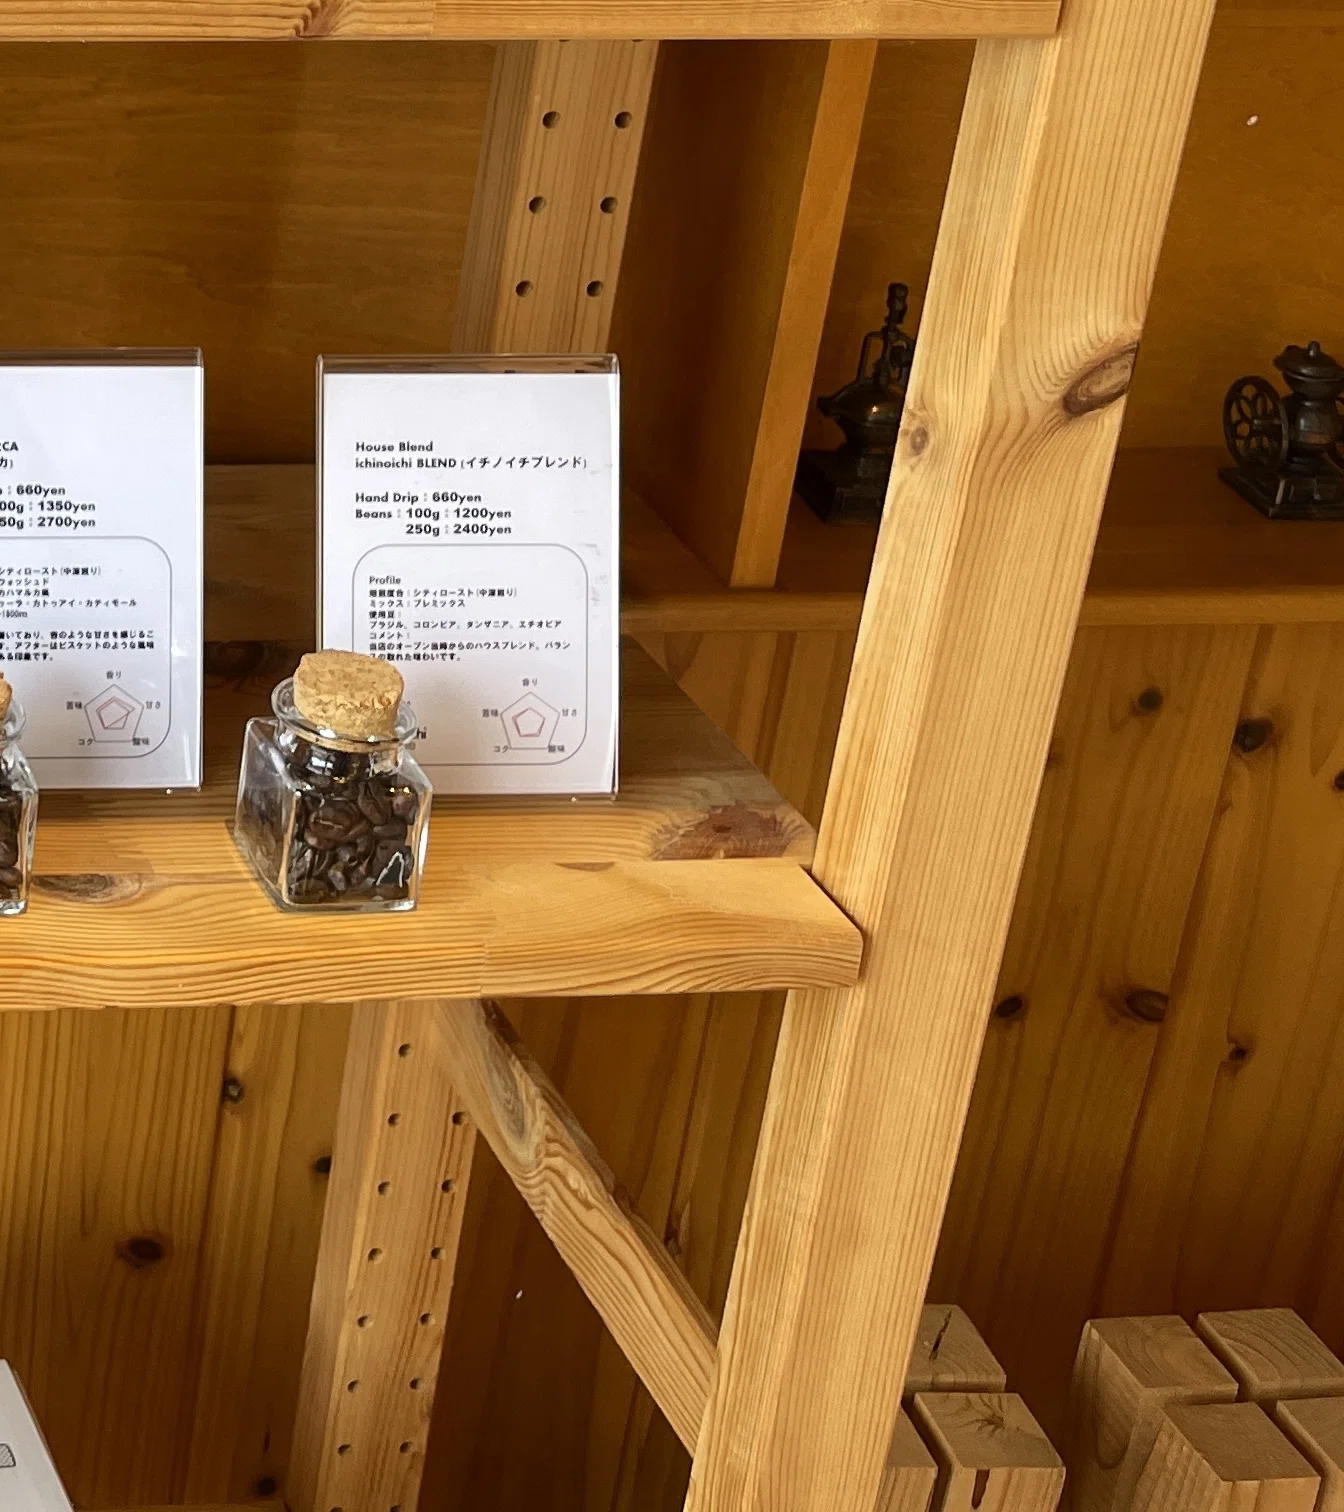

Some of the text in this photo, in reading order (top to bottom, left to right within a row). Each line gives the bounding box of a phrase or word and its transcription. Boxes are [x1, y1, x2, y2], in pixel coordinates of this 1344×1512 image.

[356, 442, 433, 452] House Blend
[355, 456, 587, 469] ichinoichi BLEND (イチノイチブレンド)
[355, 493, 388, 503] Hand
